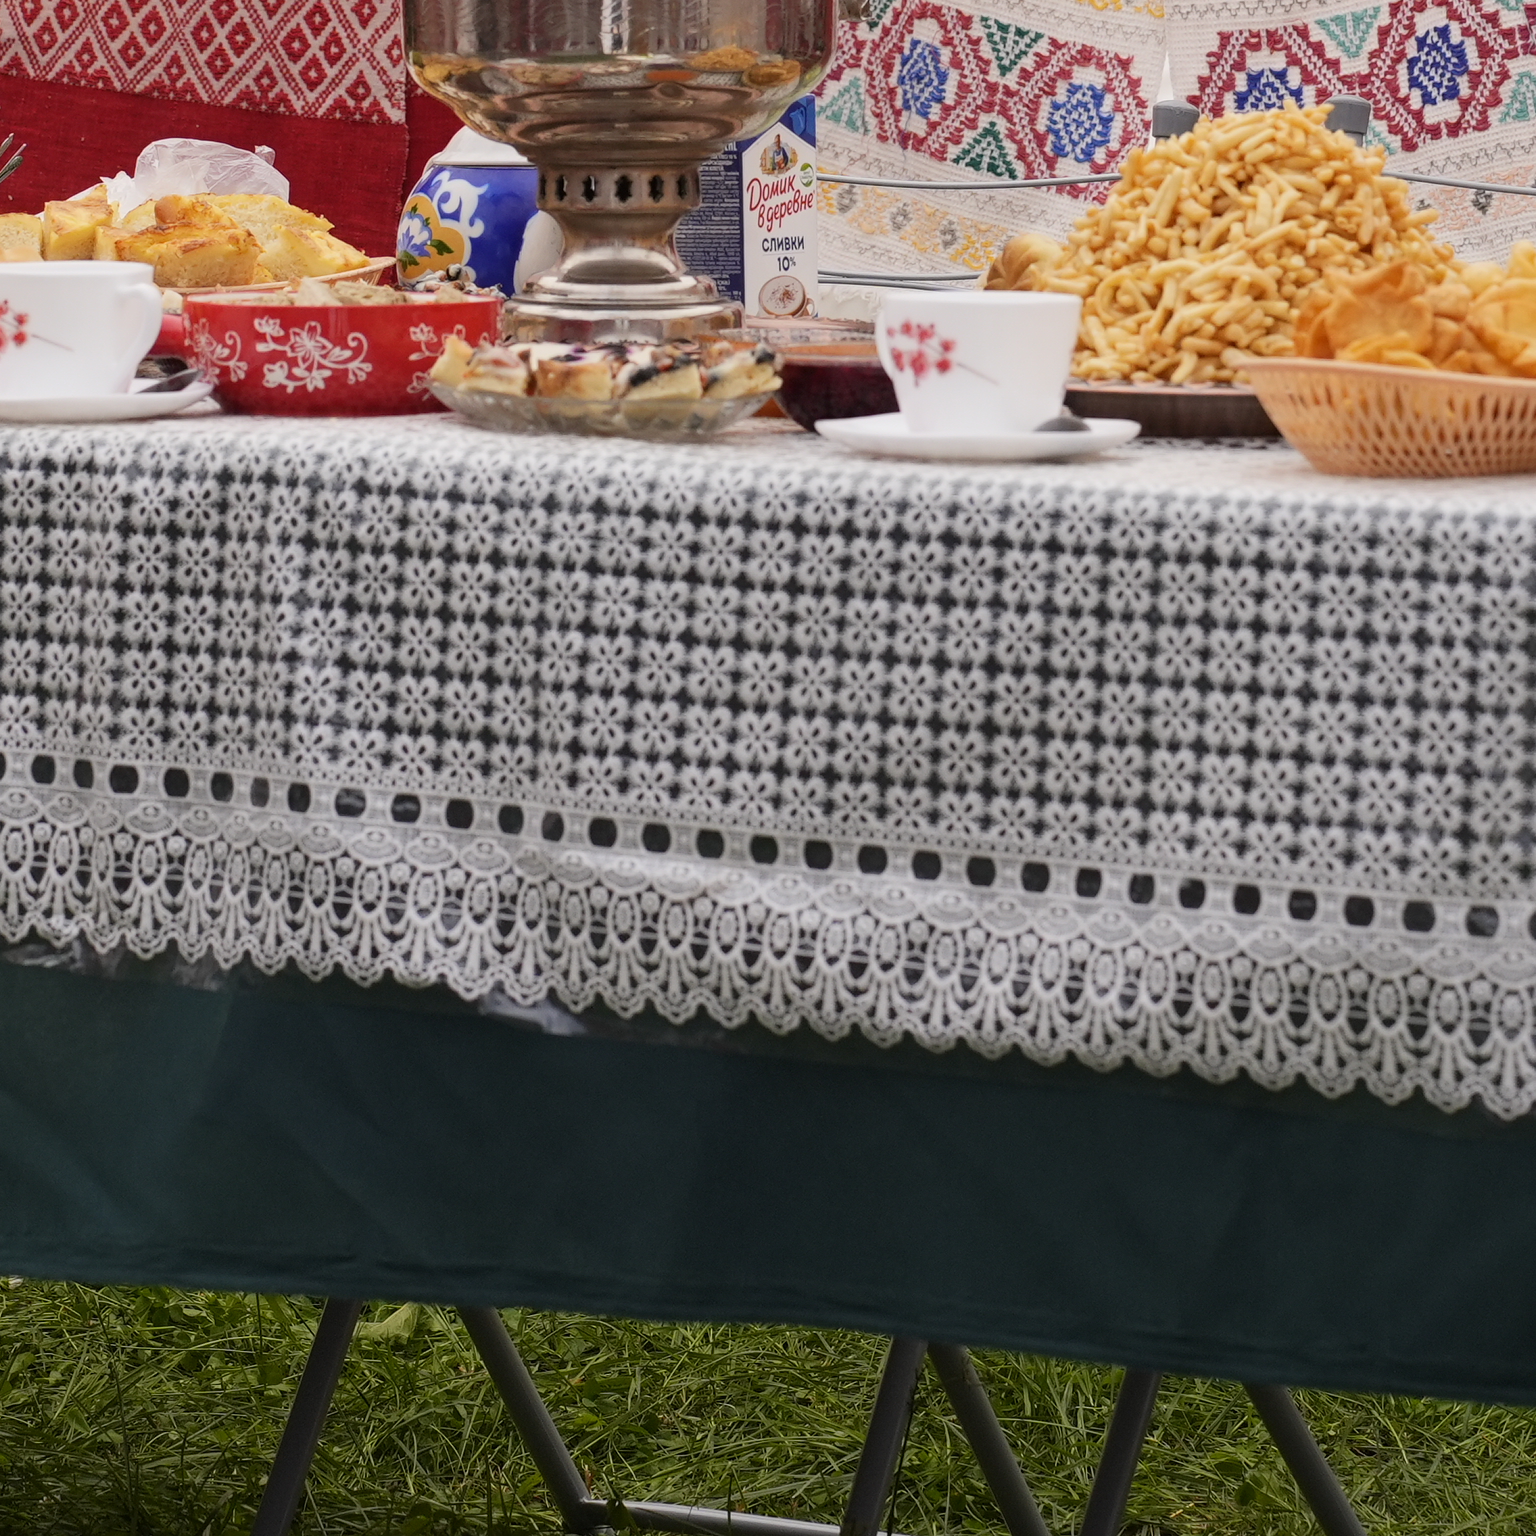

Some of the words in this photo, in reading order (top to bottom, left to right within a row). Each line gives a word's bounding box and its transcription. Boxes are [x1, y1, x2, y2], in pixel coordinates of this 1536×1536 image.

[746, 174, 796, 211] Домик
[761, 236, 805, 252] СЛИВКИ
[777, 256, 796, 272] 10%
